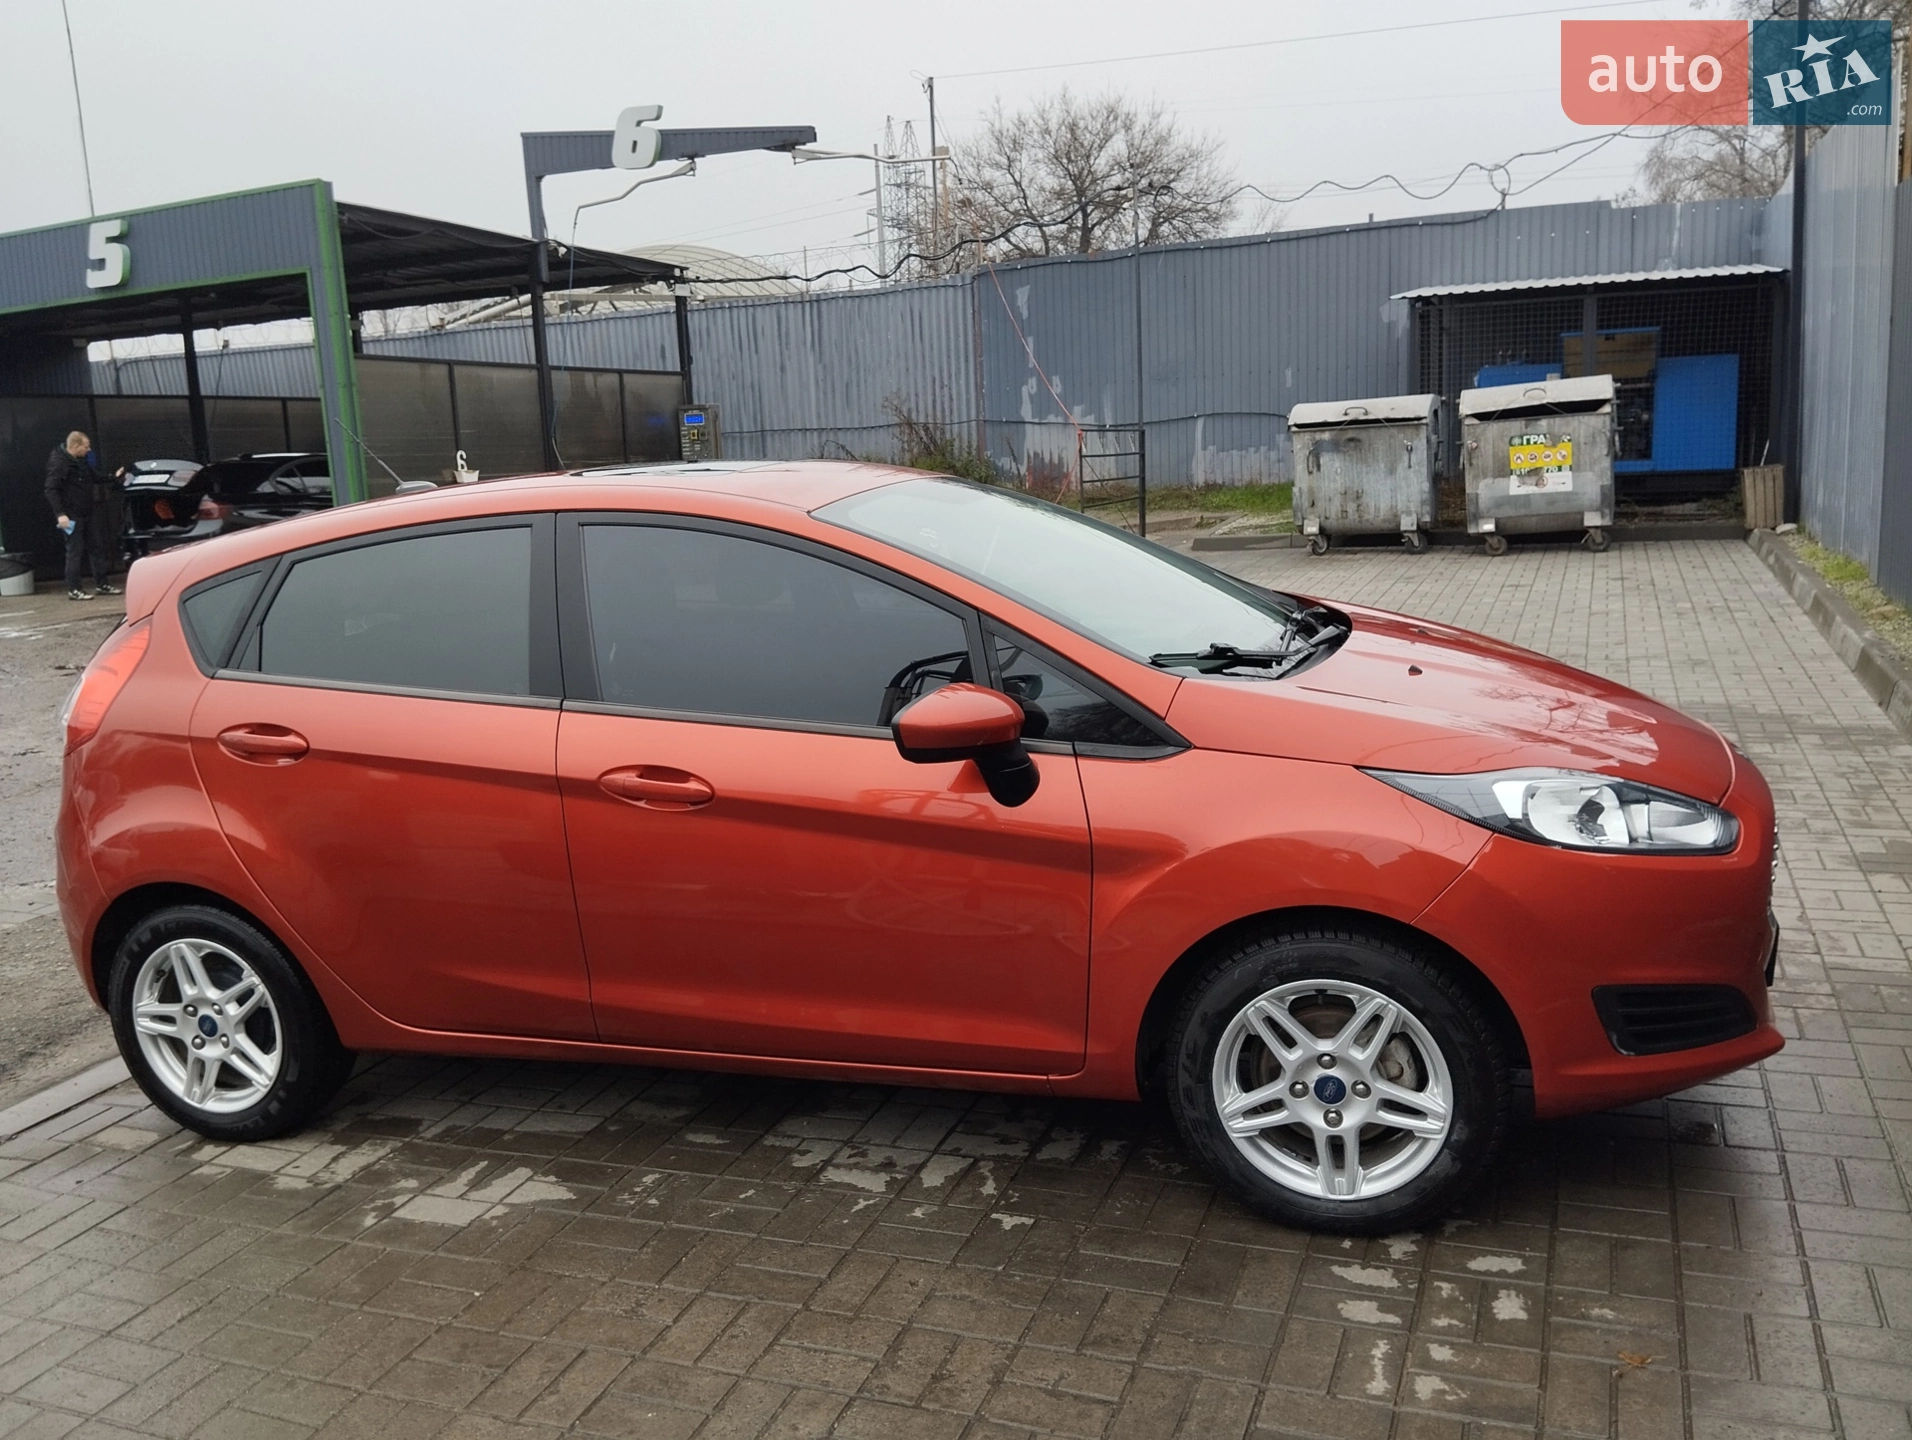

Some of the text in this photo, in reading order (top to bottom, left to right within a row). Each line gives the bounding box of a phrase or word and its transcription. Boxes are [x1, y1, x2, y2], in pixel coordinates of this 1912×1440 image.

[611, 105, 663, 170] 6
[86, 219, 130, 289] 5
[456, 450, 468, 471] 6
